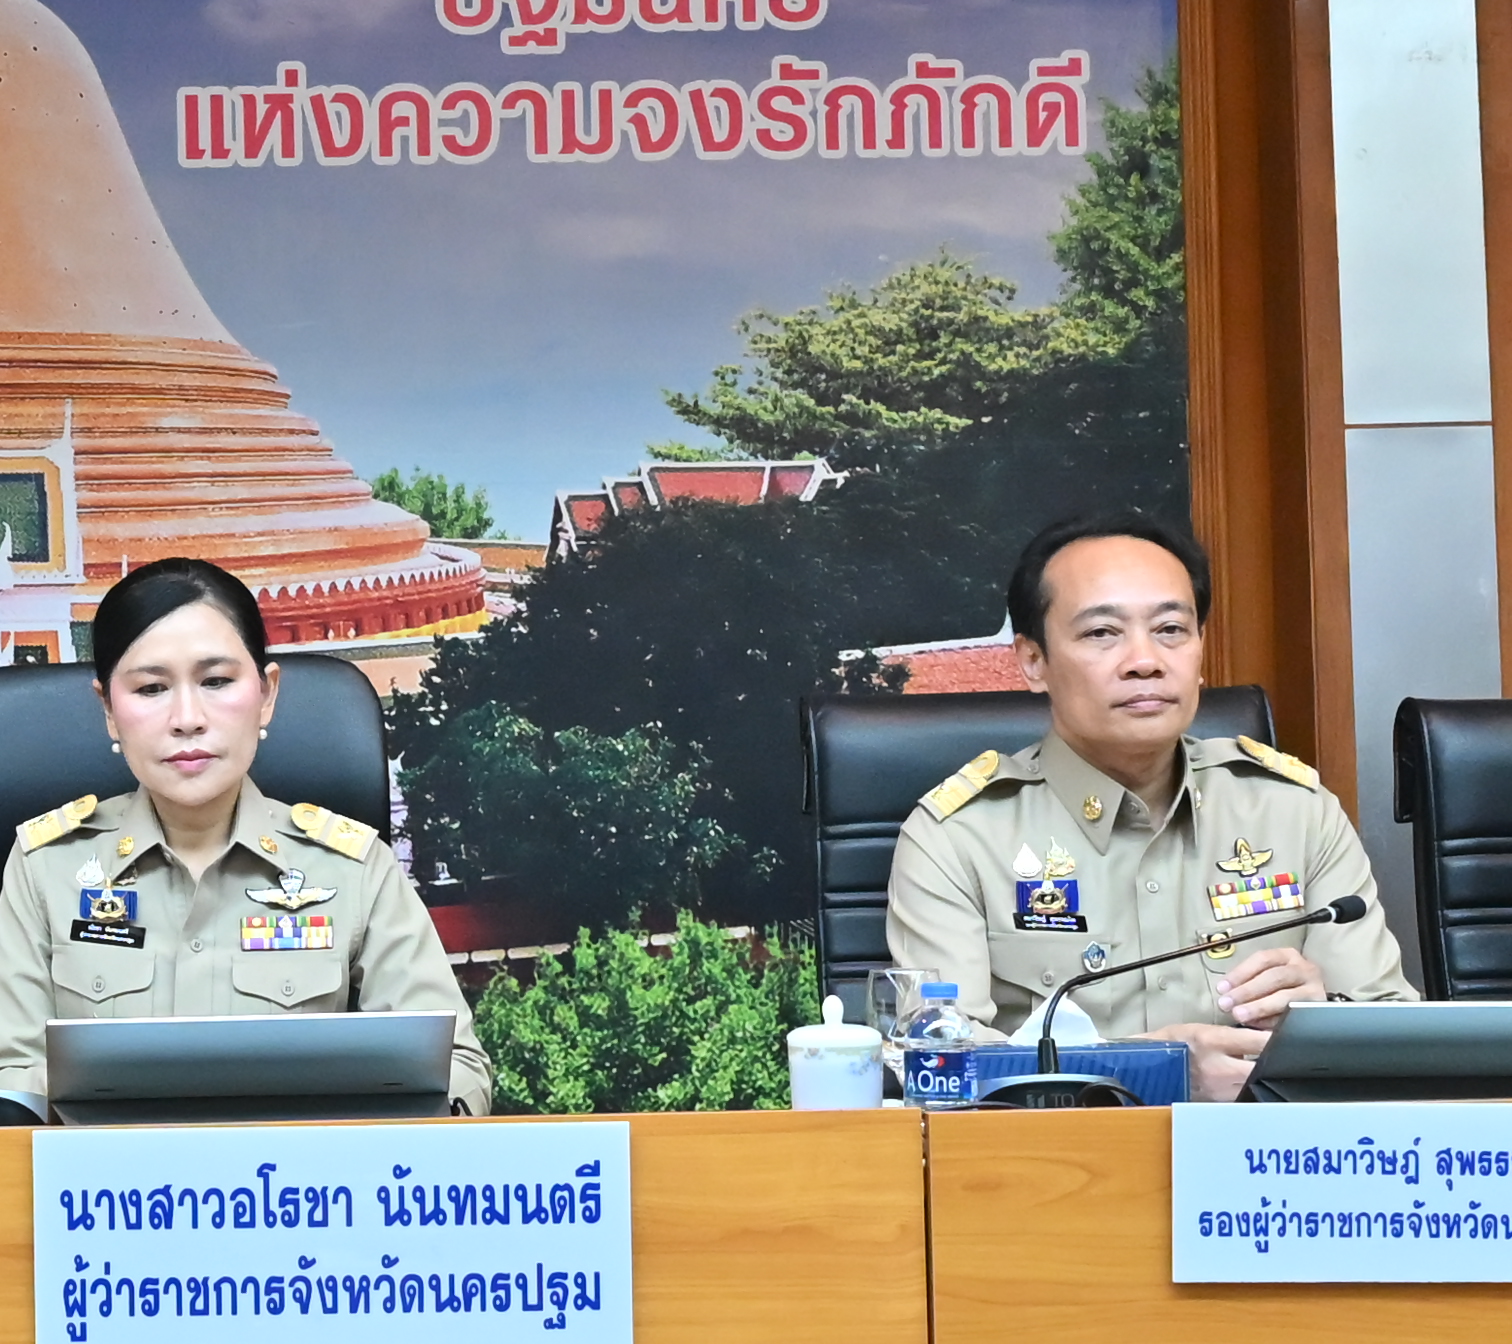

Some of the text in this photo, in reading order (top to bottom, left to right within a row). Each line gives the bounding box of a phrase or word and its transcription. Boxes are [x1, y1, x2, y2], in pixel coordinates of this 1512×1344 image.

[178, 52, 1088, 165] แห่งความจงรักภักดี
[907, 1068, 961, 1093] A One
[1050, 1093, 1077, 1107] TO
[59, 1159, 602, 1232] นางสาวอโรชา นันทมนตรี
[62, 1253, 601, 1343] ผู้ว่าราชการจังหวัดนครปฐม
